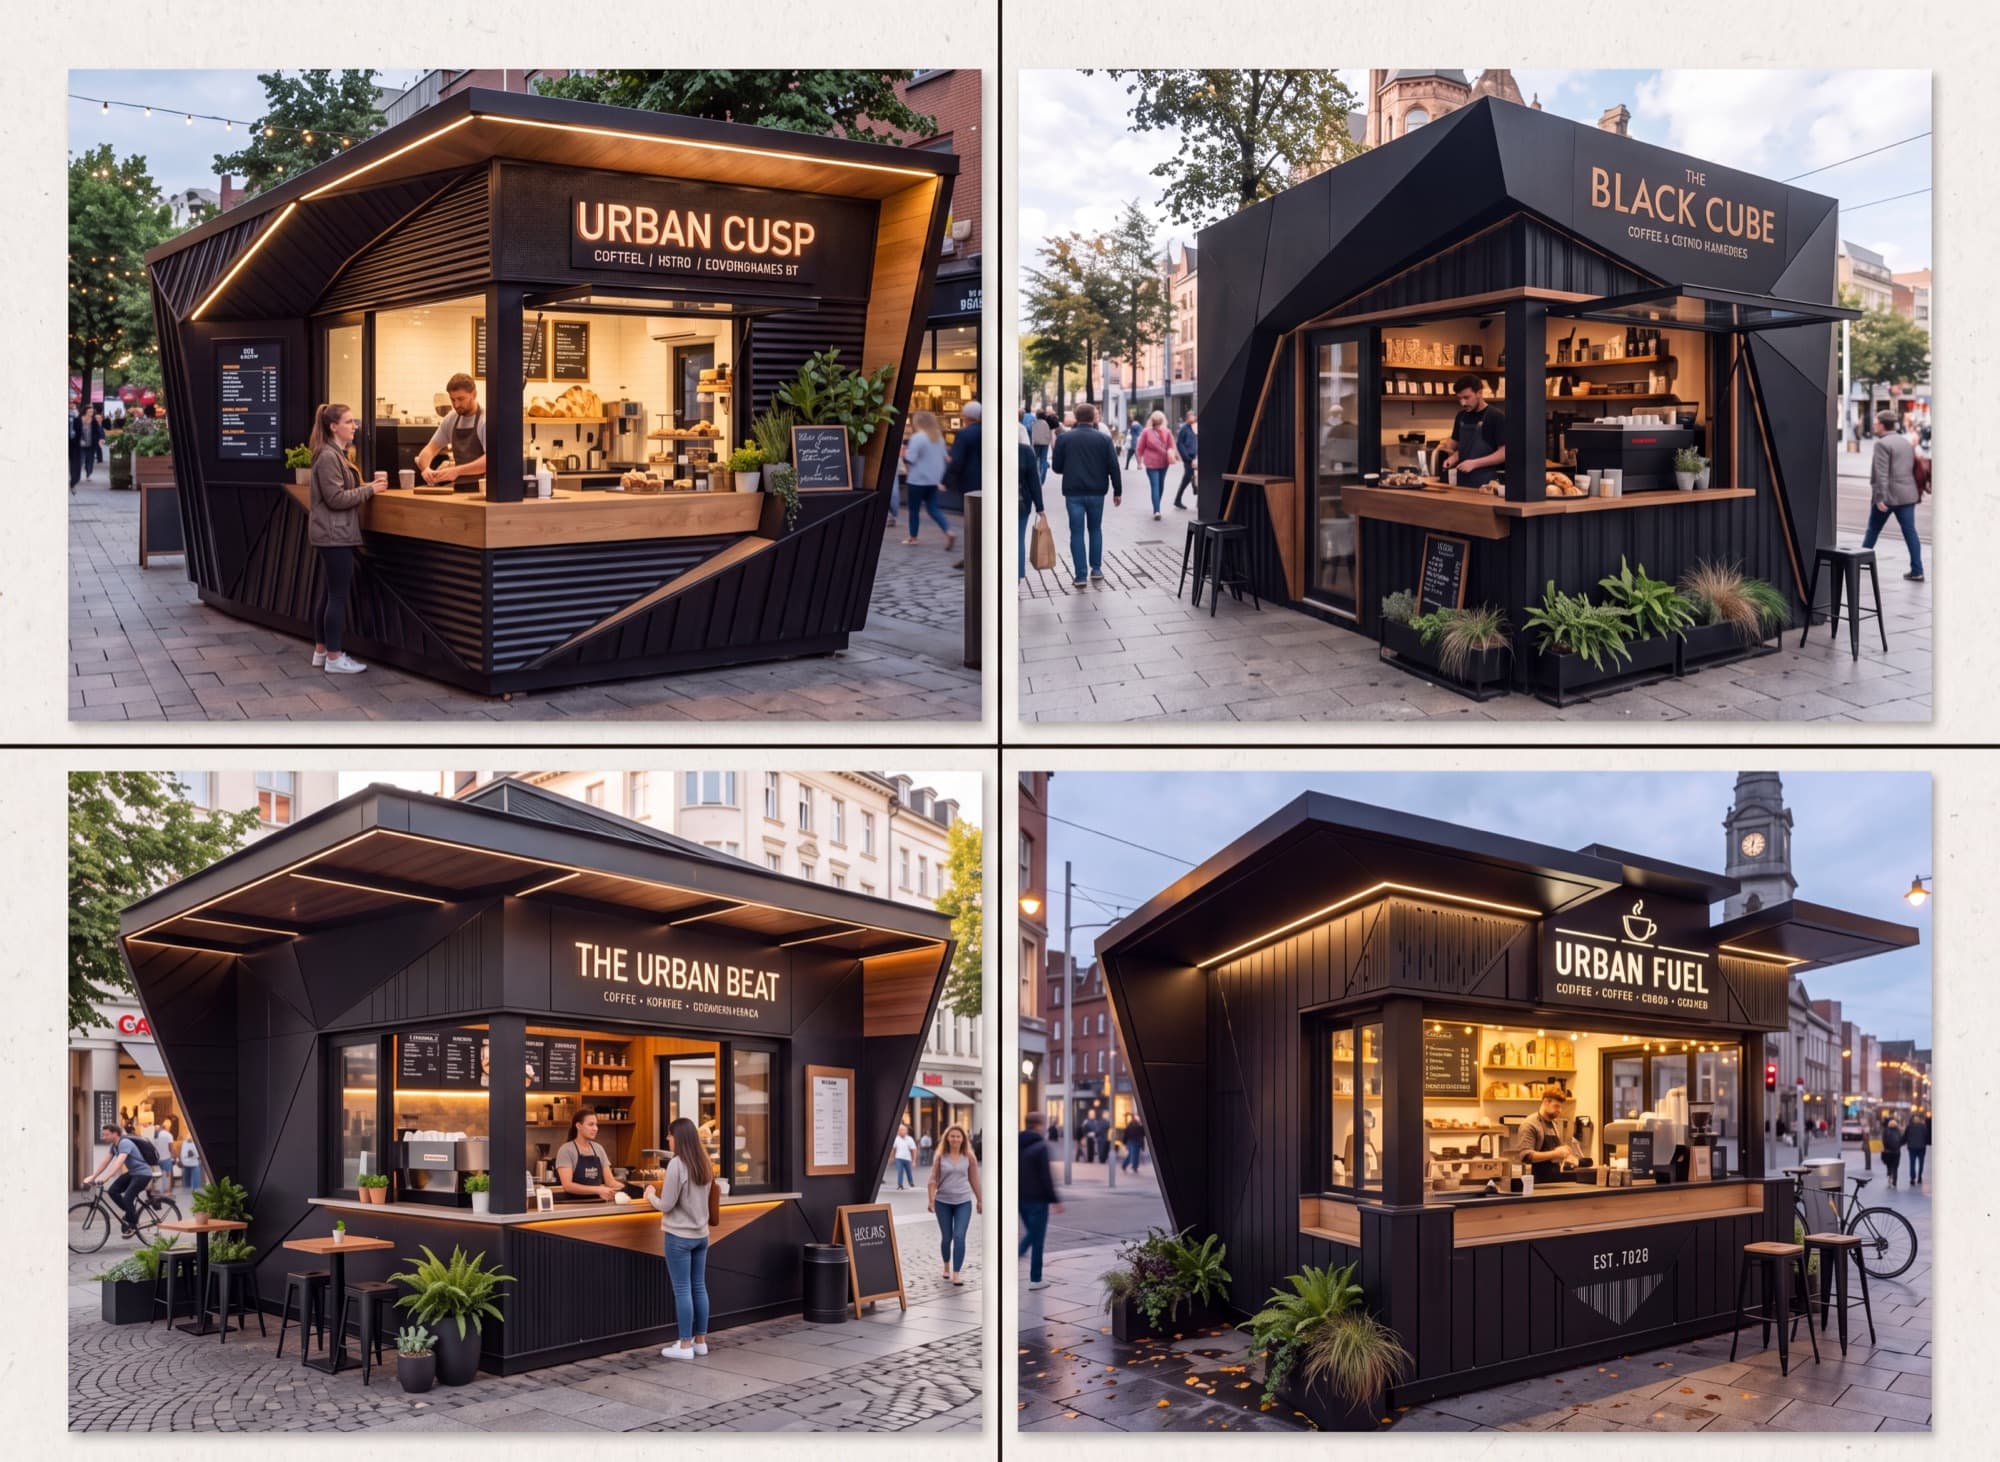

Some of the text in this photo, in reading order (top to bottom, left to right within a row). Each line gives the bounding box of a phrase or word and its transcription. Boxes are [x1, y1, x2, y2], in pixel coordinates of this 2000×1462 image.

[1685, 169, 1707, 187] THE
[1591, 166, 1776, 245] BLACK CUBE
[578, 201, 815, 256] URBAN CUSP
[1628, 226, 1662, 243] COFFEE
[575, 941, 780, 1002] THE URBAN BEAT
[1555, 940, 1709, 994] URBAN FUEL
[603, 991, 637, 1005] COFFEE
[1601, 987, 1633, 1001] COFFEE
